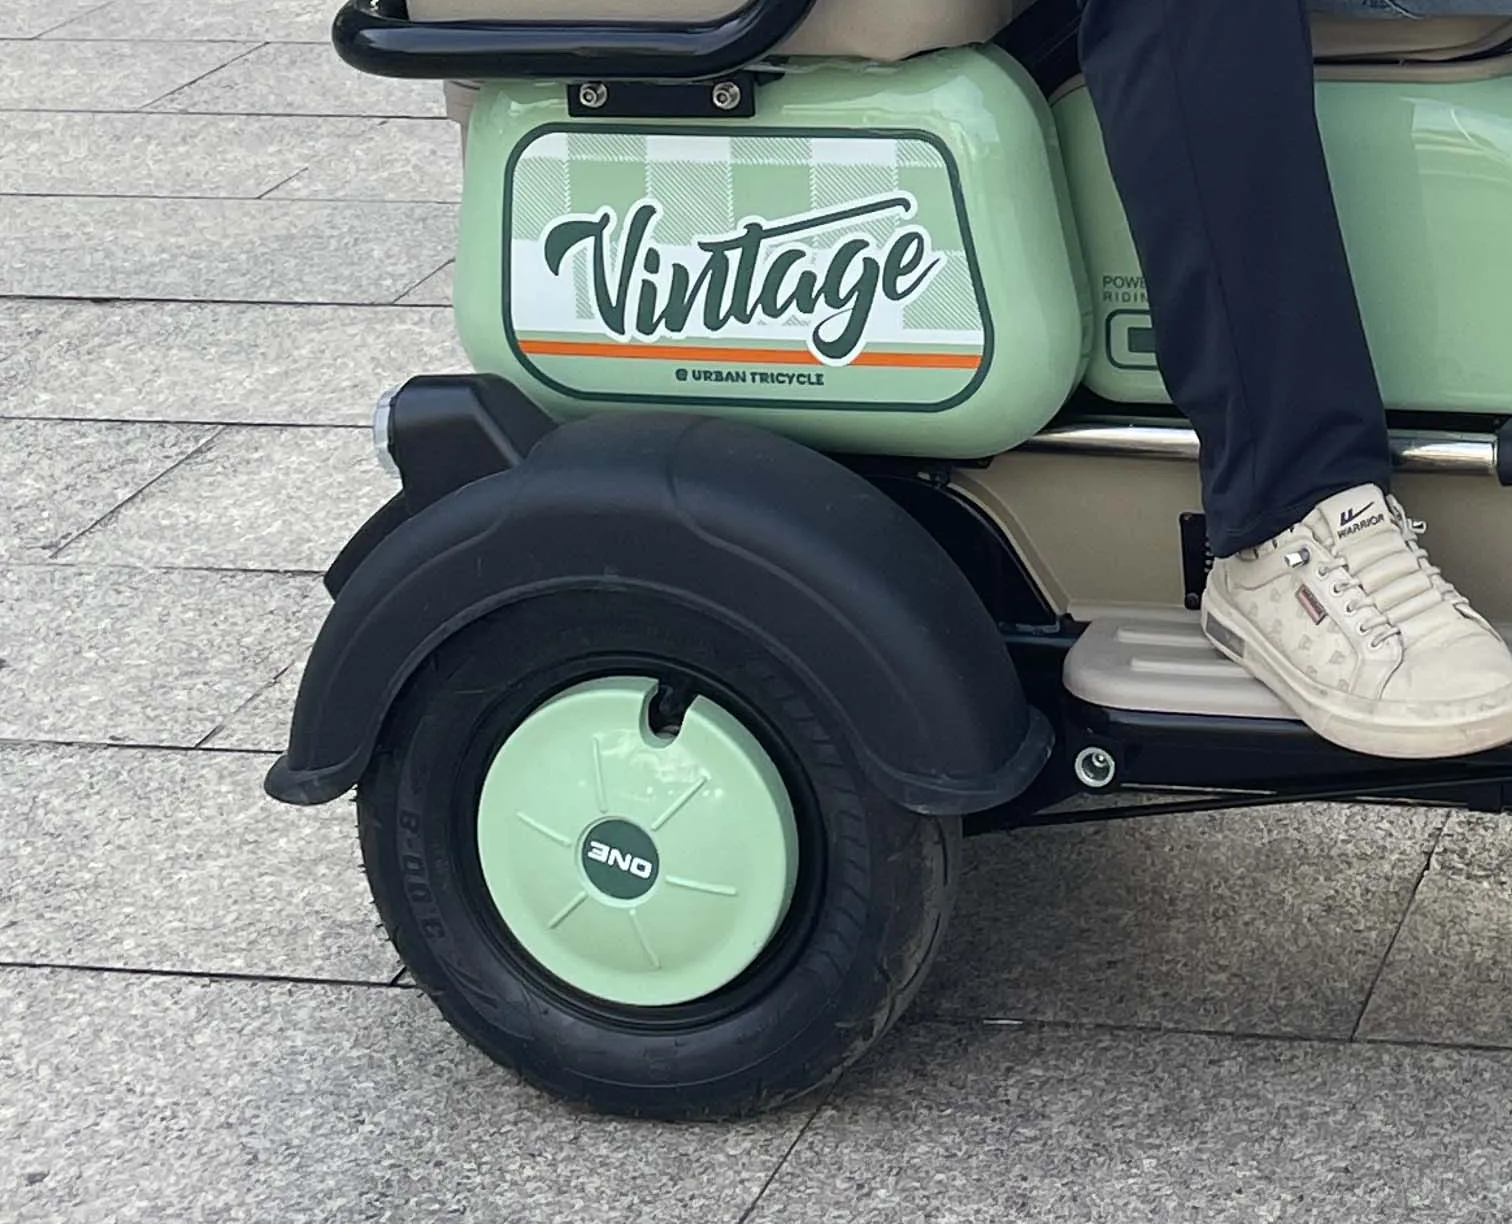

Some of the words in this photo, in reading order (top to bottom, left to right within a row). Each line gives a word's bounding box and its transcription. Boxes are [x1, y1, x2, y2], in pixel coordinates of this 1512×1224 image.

[544, 197, 941, 359] Vintage
[692, 369, 747, 384] URBAN
[750, 372, 824, 386] TRICYCLE
[1337, 514, 1385, 539] WARRIOR
[587, 840, 653, 879] ONE
